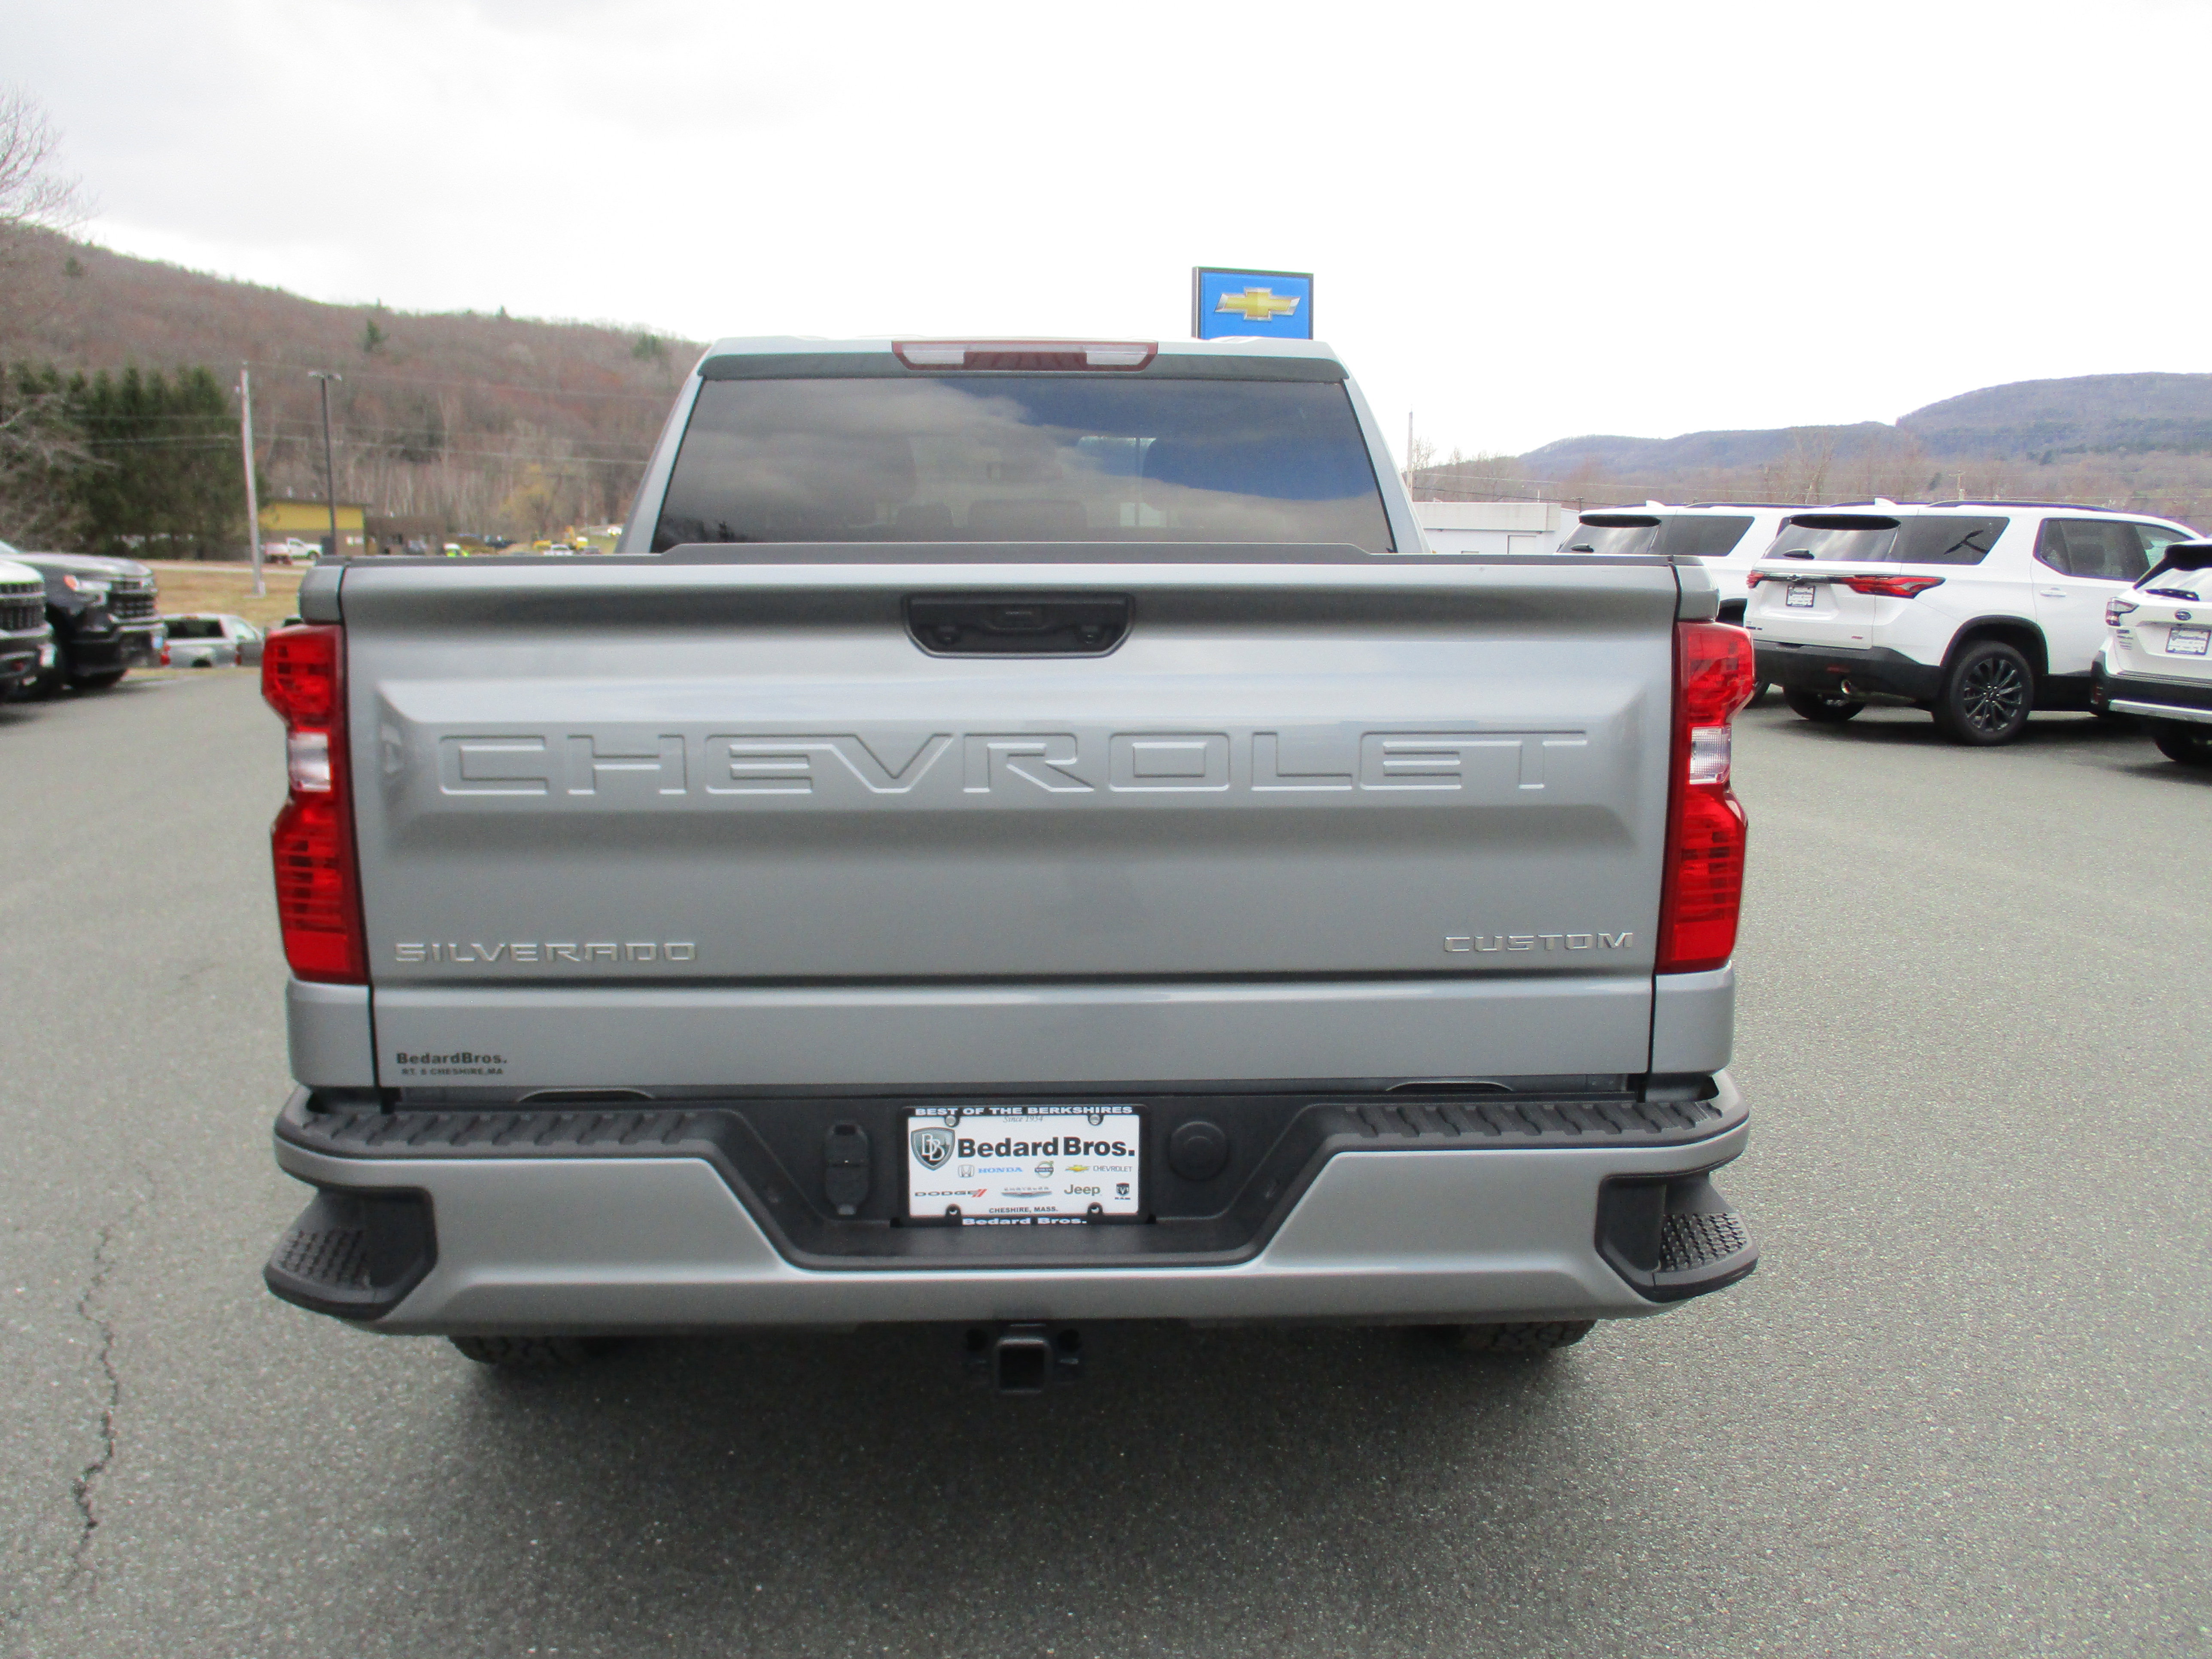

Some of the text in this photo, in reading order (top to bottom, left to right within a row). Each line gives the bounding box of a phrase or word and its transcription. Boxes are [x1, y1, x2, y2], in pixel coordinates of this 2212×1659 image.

[439, 729, 1589, 796] CHEVROLET
[395, 942, 696, 962] SILVERADO
[1443, 933, 1634, 952] CUSTOM
[915, 1106, 1133, 1116] BEST OF THE BERKSHIRES
[958, 1136, 1136, 1158] Bedard Bros.
[1063, 1184, 1101, 1196] Jeep
[962, 1217, 1087, 1226] Bedard Bros.
